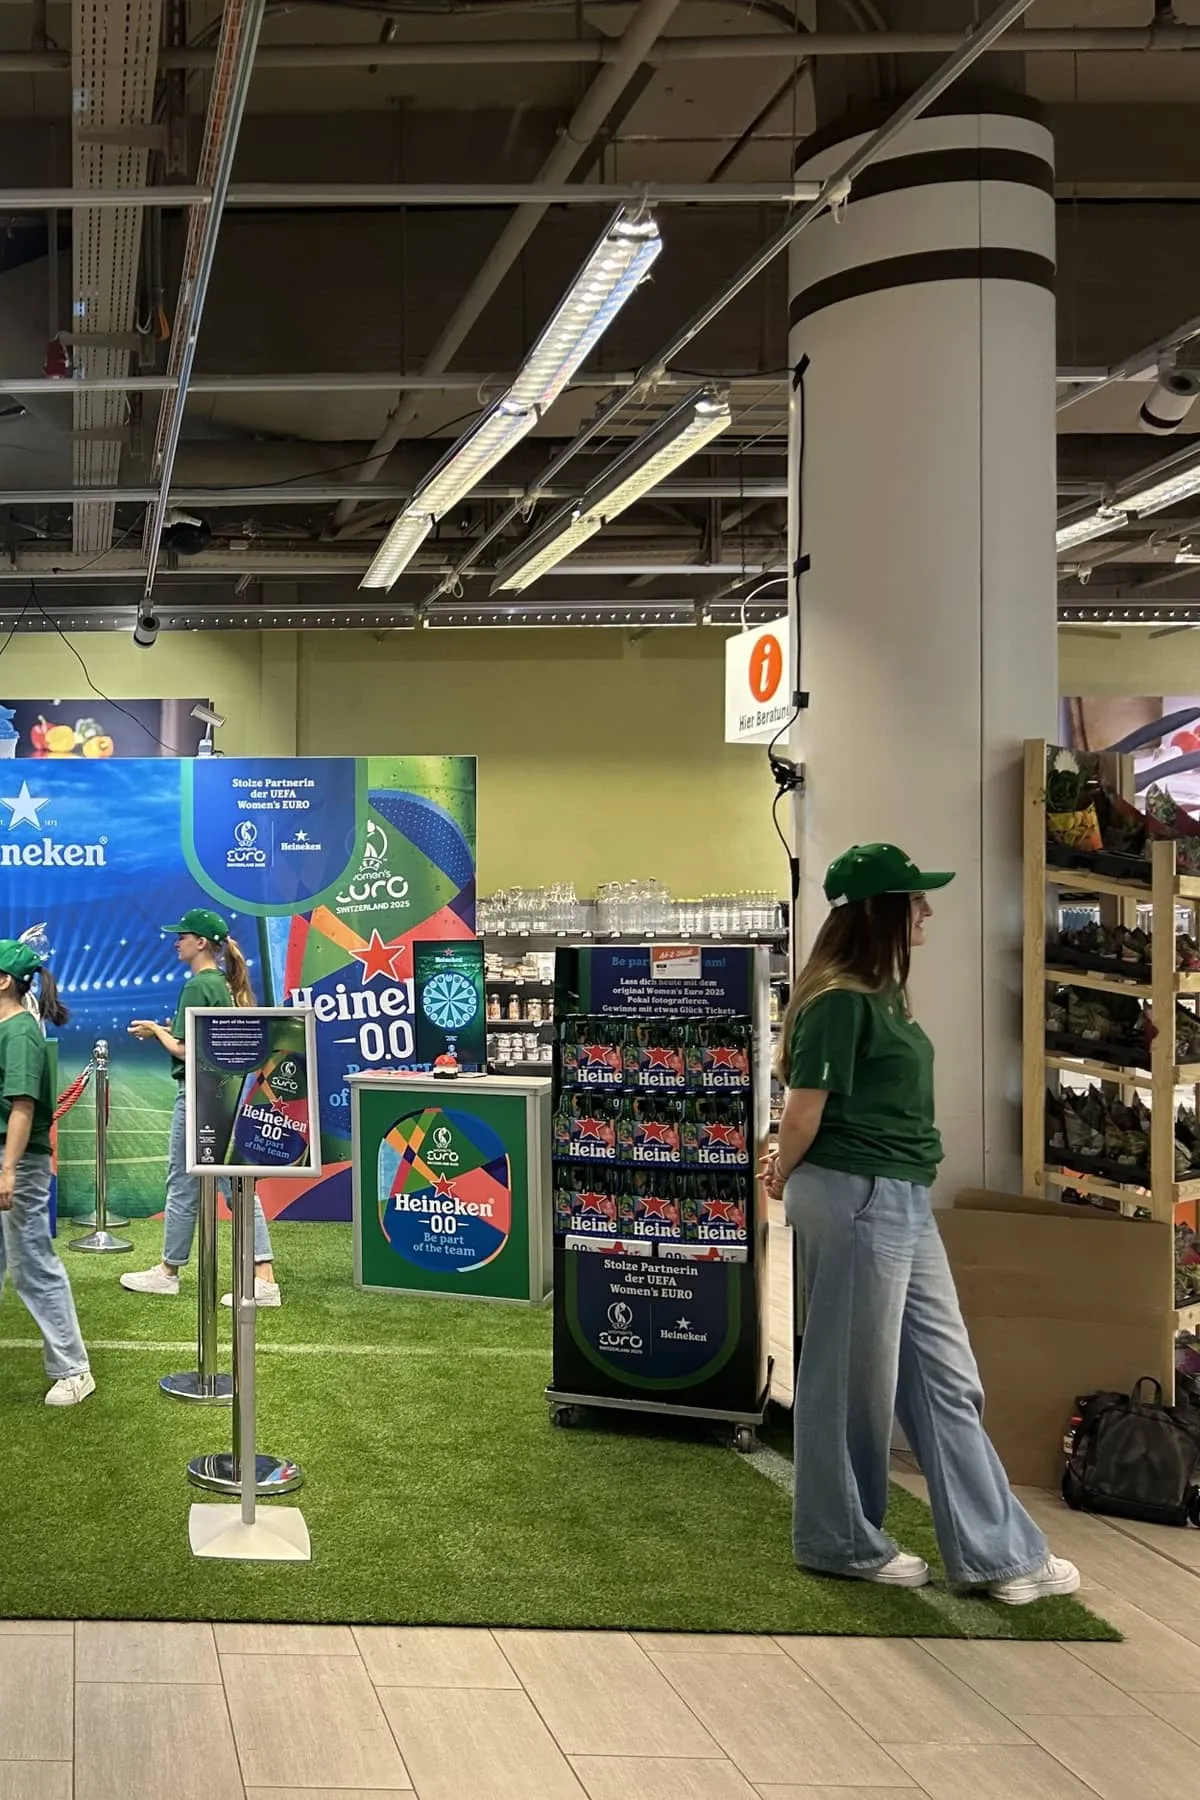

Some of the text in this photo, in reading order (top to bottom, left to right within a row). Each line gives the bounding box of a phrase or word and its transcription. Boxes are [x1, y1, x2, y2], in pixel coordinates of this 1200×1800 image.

[739, 714, 755, 732] Hier
[231, 778, 315, 788] Stolze Partnerin
[250, 789, 296, 799] der UEFA
[237, 800, 310, 810] Women's EURO
[281, 842, 321, 851] Heineken
[336, 900, 410, 914] SWITZERLAND 2025
[612, 956, 626, 966] Be
[628, 957, 648, 969] par
[704, 957, 727, 967] am!
[639, 977, 657, 985] dich
[658, 978, 681, 986] heute
[683, 978, 698, 986] mit
[612, 987, 645, 996] original
[684, 988, 704, 996] Euro
[705, 988, 725, 996] 2025
[289, 977, 416, 1022] Heine
[627, 996, 710, 1006] Pokal fotografieren.
[602, 1004, 638, 1012] Gewinne
[639, 1005, 652, 1013] mit
[680, 1006, 703, 1014] Glück
[705, 1007, 736, 1015] Tickets
[577, 1068, 623, 1083] Heine
[638, 1072, 686, 1087] Heine
[702, 1072, 750, 1087] Heine
[329, 1088, 349, 1107] of
[242, 1103, 307, 1133] Heineken
[265, 1138, 285, 1150] part
[569, 1142, 617, 1159] Heine
[267, 1148, 290, 1160] team
[633, 1146, 681, 1163] Heine
[698, 1149, 749, 1164] Heine
[394, 1193, 494, 1217] Heineken
[570, 1216, 617, 1233] Heine
[633, 1221, 681, 1238] Heine
[424, 1232, 464, 1245] Be part
[698, 1225, 748, 1240] Heine
[413, 1242, 476, 1257] of the team
[604, 1259, 698, 1276] Stolze Partnerin
[625, 1273, 677, 1286] der UEFA
[610, 1283, 693, 1299] Women's EURO
[660, 1329, 708, 1342] Heineken
